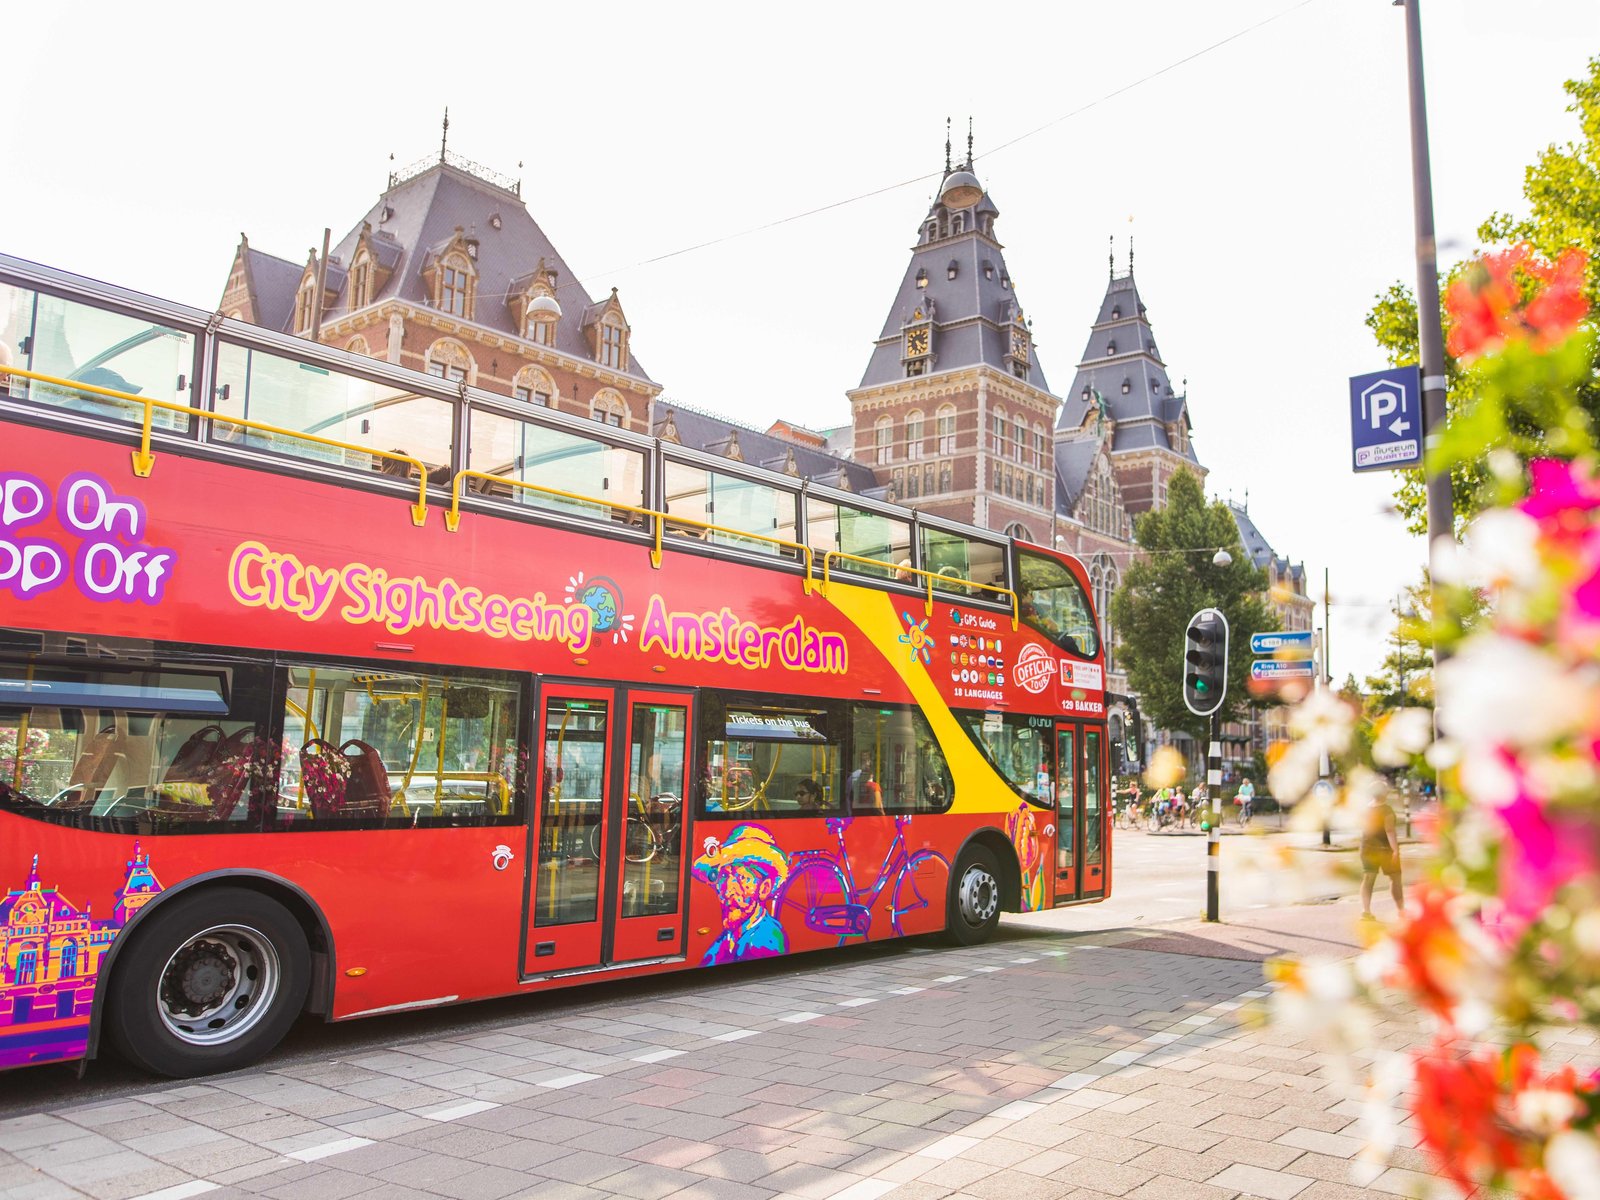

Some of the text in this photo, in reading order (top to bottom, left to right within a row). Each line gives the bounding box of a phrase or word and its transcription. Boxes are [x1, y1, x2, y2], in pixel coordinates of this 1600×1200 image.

[1370, 391, 1397, 429] P
[66, 479, 138, 535] On
[84, 542, 170, 597] Off
[964, 613, 997, 630] GPS Guide
[639, 594, 848, 674] Amsterdam
[1017, 659, 1056, 682] OFFICIAL
[1030, 675, 1048, 690] TOUR
[954, 687, 1004, 701] 18 LANGUAGES
[1061, 699, 1103, 713] 129 BAKKER
[728, 714, 811, 729] Tickets on the bus
